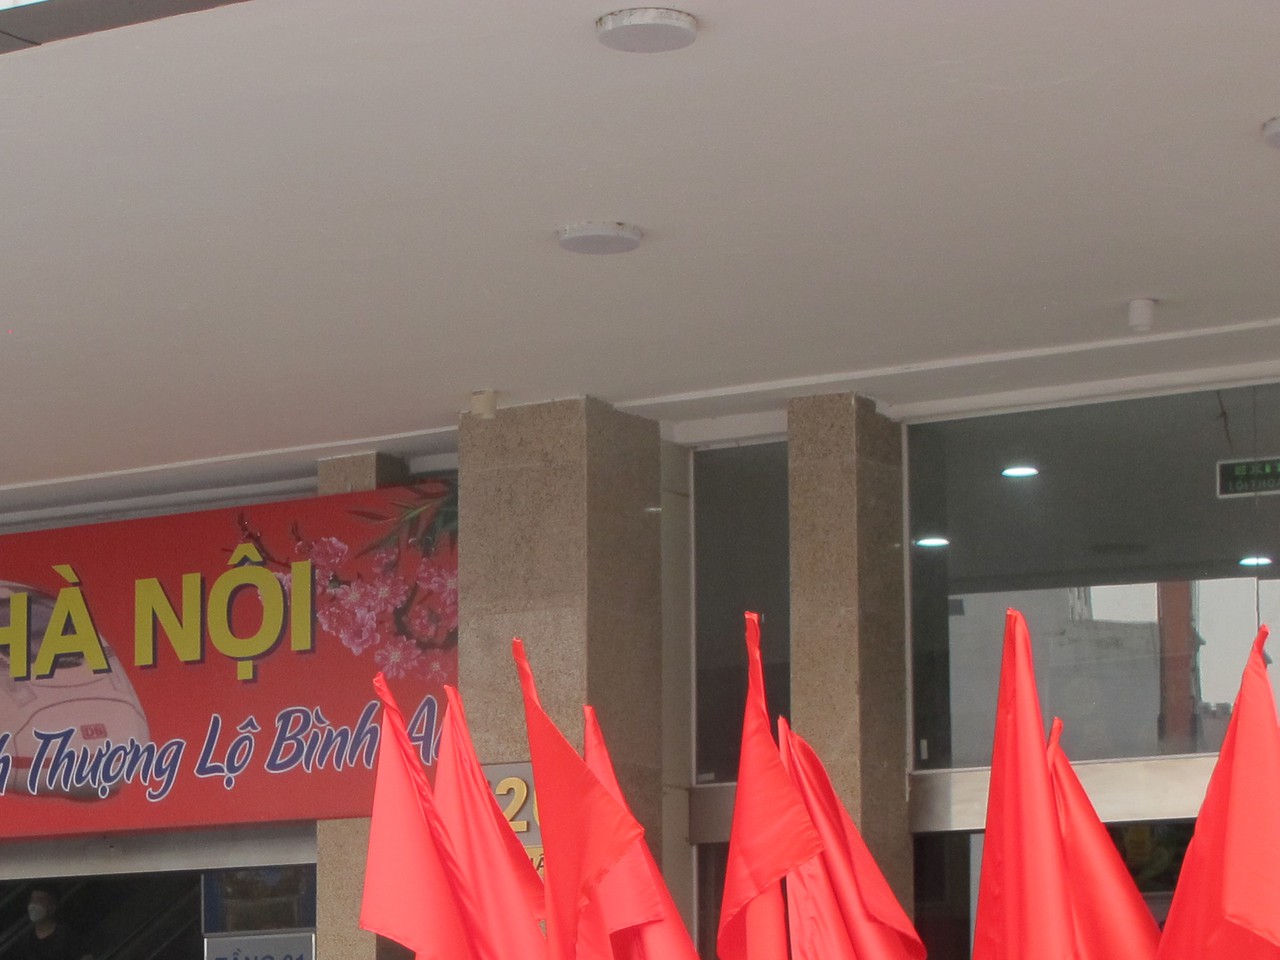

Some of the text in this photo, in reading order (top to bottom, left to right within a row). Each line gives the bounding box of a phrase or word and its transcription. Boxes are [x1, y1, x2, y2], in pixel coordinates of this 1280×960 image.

[133, 542, 316, 684] NỘI
[27, 726, 186, 802] Thượng
[194, 713, 261, 791] Lộ
[264, 700, 381, 774] Bình
[405, 694, 439, 767] A
[494, 776, 543, 833] 2
